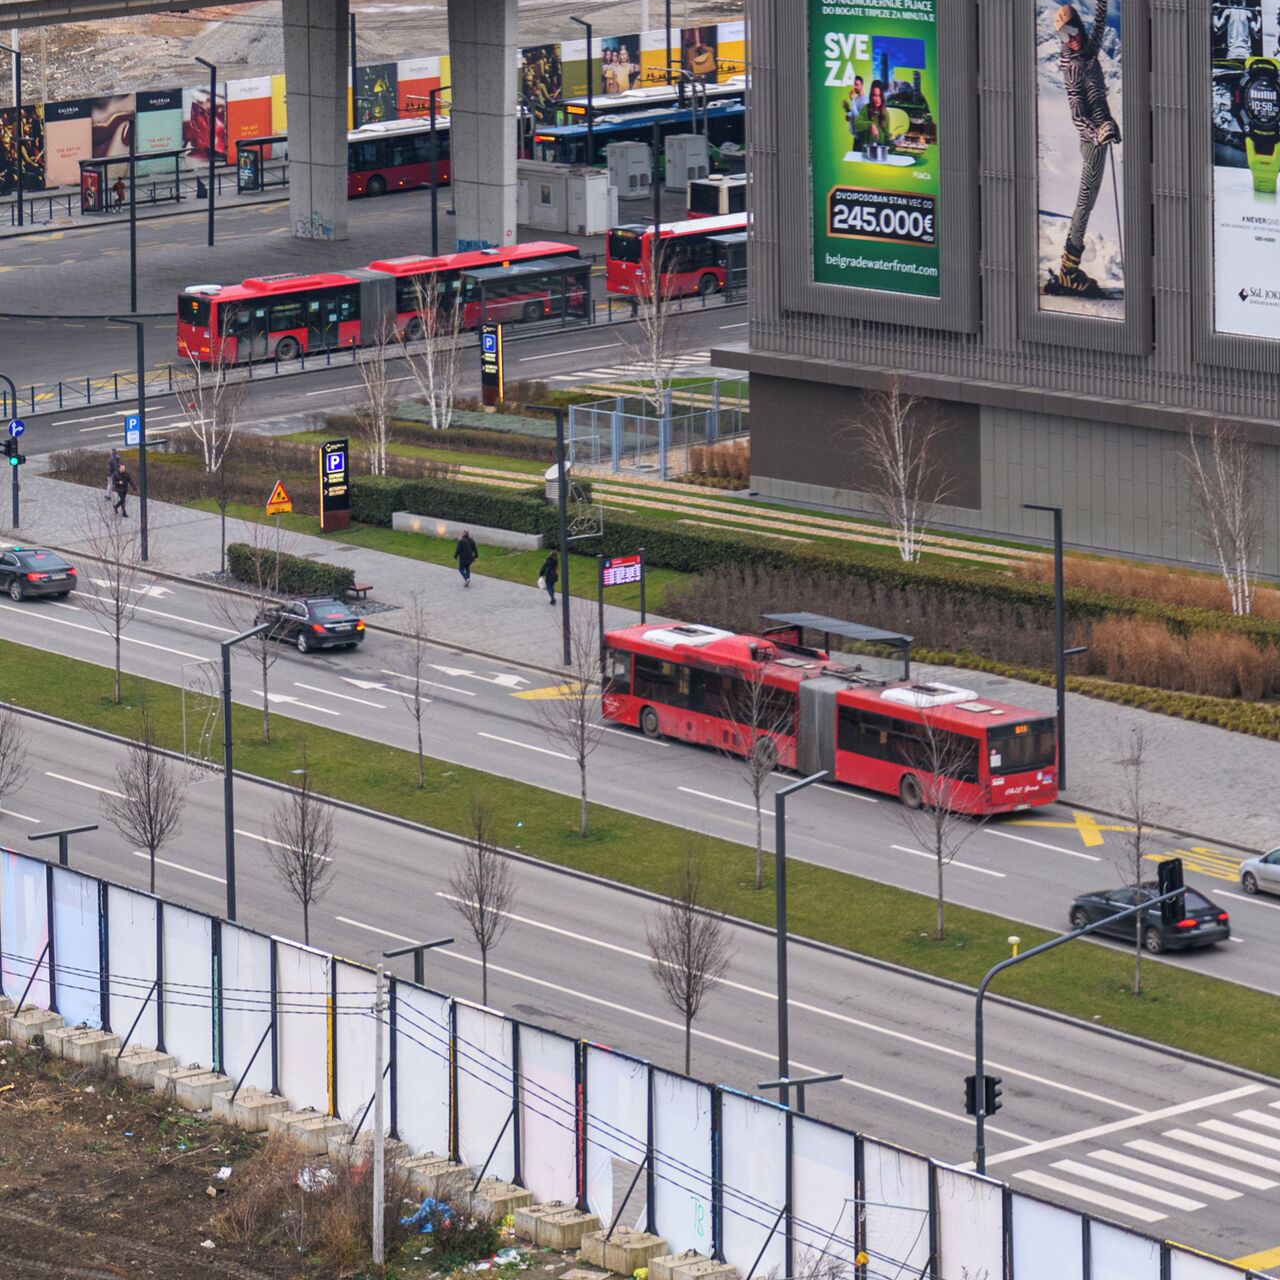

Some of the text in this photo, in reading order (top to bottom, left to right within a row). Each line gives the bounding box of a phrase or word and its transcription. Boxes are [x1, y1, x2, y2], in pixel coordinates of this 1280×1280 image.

[822, 6, 835, 15] DO
[835, 7, 864, 17] BOGATE
[864, 8, 891, 19] TRPEZE
[891, 10, 901, 19] ZA
[904, 0, 933, 12] PIJACE
[824, 32, 870, 60] SVE
[824, 61, 856, 87] ZA
[835, 192, 888, 203] DVOIPOSOBAN
[888, 196, 907, 205] STAN
[923, 200, 933, 209] OD
[832, 204, 934, 237] 245.000€
[825, 252, 938, 277] belgradewaterfront.com
[330, 455, 340, 470] P
